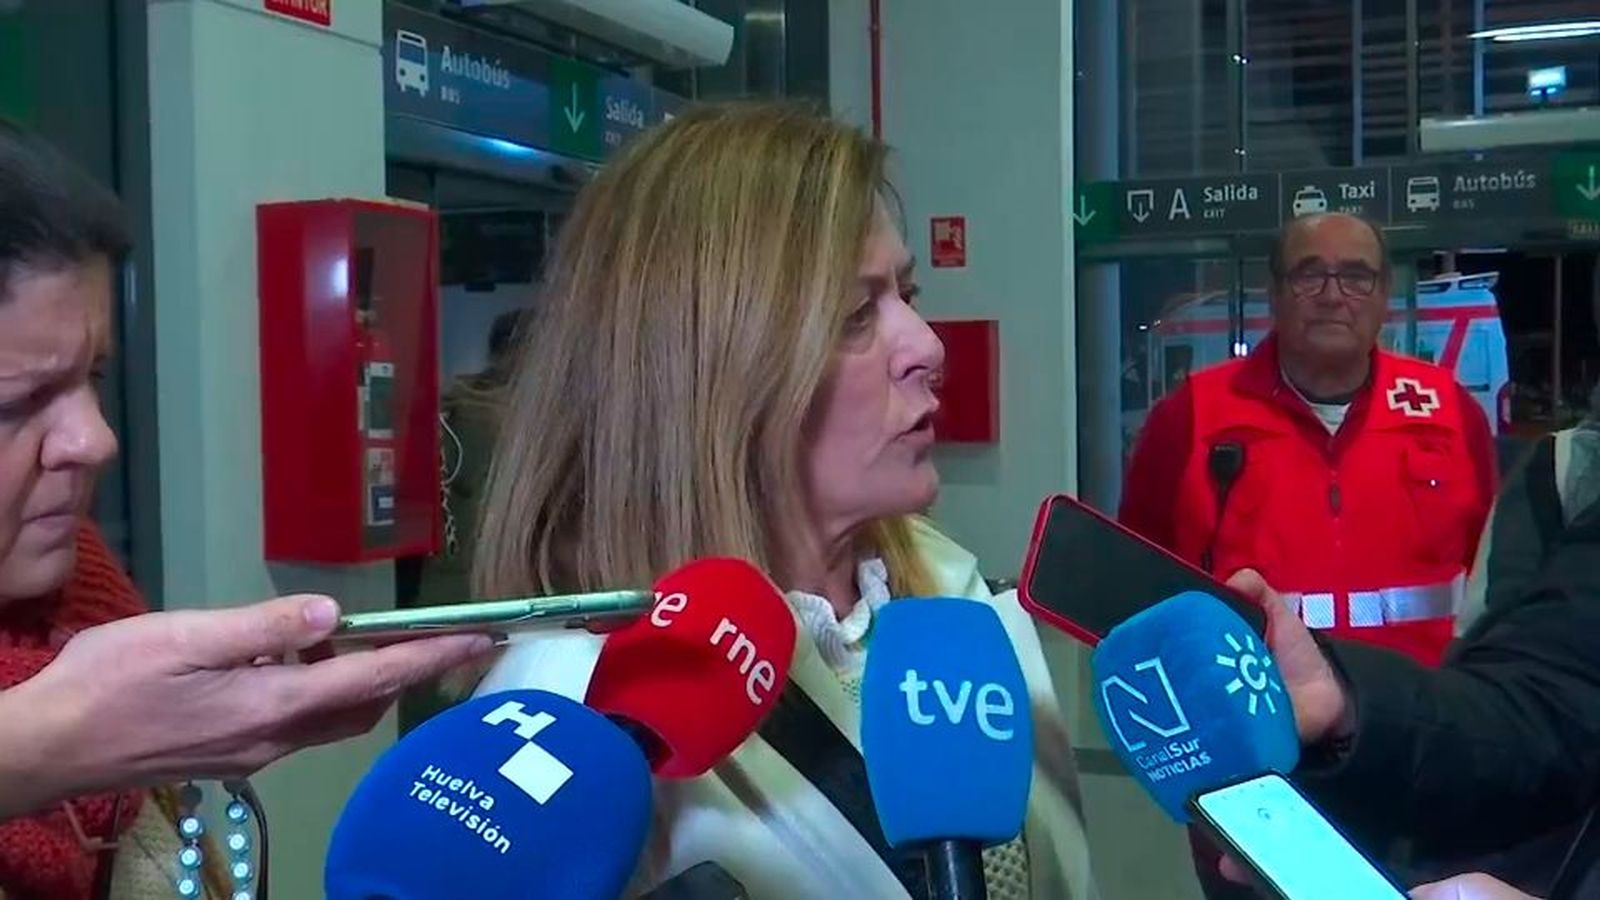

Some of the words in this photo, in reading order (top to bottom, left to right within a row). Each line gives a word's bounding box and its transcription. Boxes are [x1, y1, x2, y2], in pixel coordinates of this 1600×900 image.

[441, 45, 510, 90] Autobús
[605, 96, 643, 129] Salida
[1338, 180, 1375, 200] Taxi
[1453, 170, 1536, 192] Autobús
[1168, 188, 1190, 220] A
[1203, 184, 1258, 202] Salida
[709, 617, 776, 705] rne
[899, 669, 1014, 740] tve
[1147, 751, 1213, 783] NOTICIAS
[420, 764, 495, 811] Huelva
[409, 781, 511, 855] Televisión
